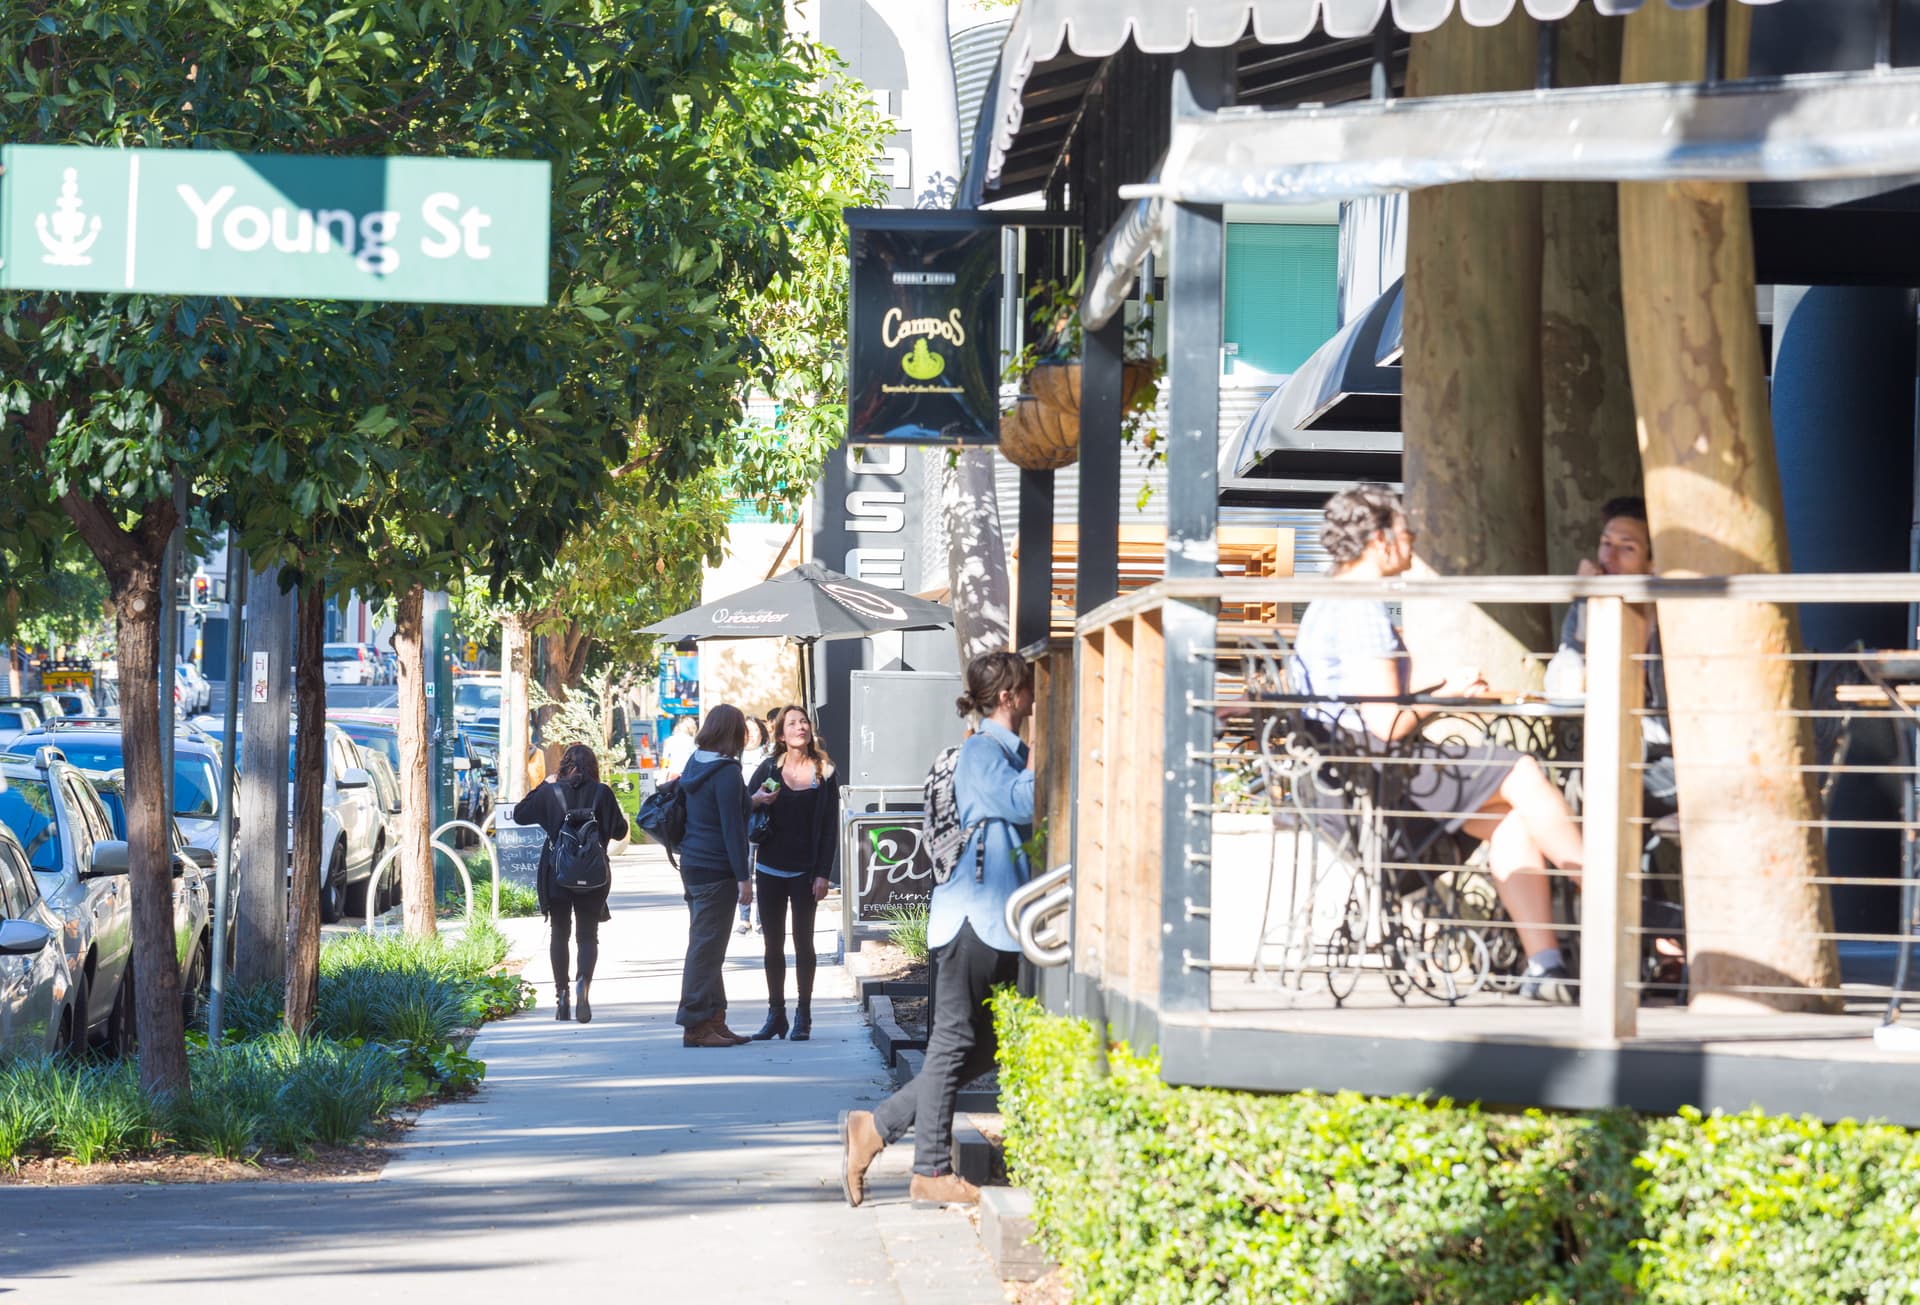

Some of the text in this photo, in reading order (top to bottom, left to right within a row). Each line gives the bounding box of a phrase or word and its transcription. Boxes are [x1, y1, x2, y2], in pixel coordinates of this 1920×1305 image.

[176, 184, 492, 274] Young St
[724, 610, 790, 624] roaster
[888, 890, 931, 903] furni
